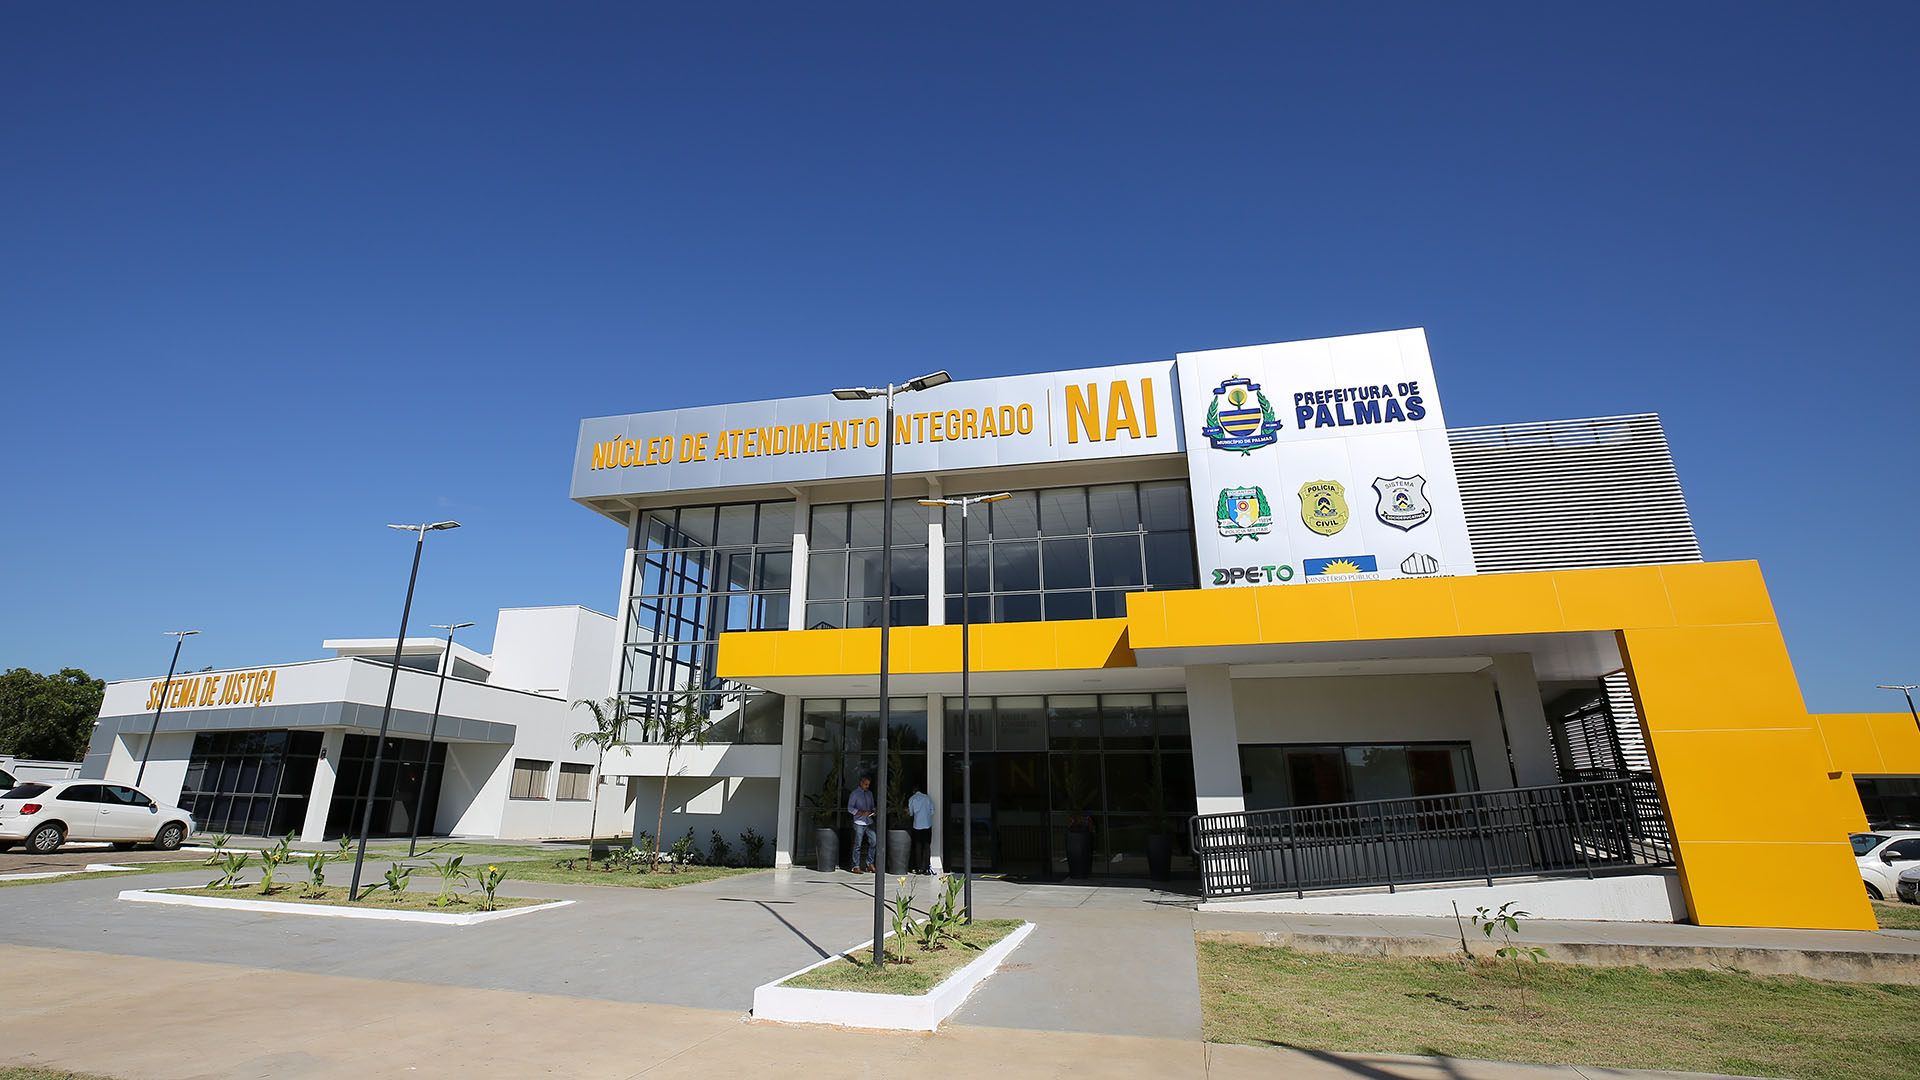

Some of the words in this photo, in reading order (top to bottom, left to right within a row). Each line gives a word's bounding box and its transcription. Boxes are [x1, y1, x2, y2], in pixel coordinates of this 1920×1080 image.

[1293, 384, 1393, 406] PREFEITURA
[1397, 381, 1420, 397] DE
[1065, 377, 1158, 444] NAI
[1295, 396, 1426, 430] PALMAS
[592, 434, 673, 470] NÚCLEO
[680, 432, 709, 463] DE
[714, 416, 880, 460] ATENDIMENTO
[892, 403, 1034, 445] NTEGRADO
[1384, 480, 1415, 489] SISTEMA
[1315, 519, 1340, 528] CIVIL
[1348, 573, 1379, 581] PÚBLICO
[146, 678, 201, 710] SISTEMA
[199, 676, 221, 706] DE
[218, 669, 277, 708] JUSTIÇA
